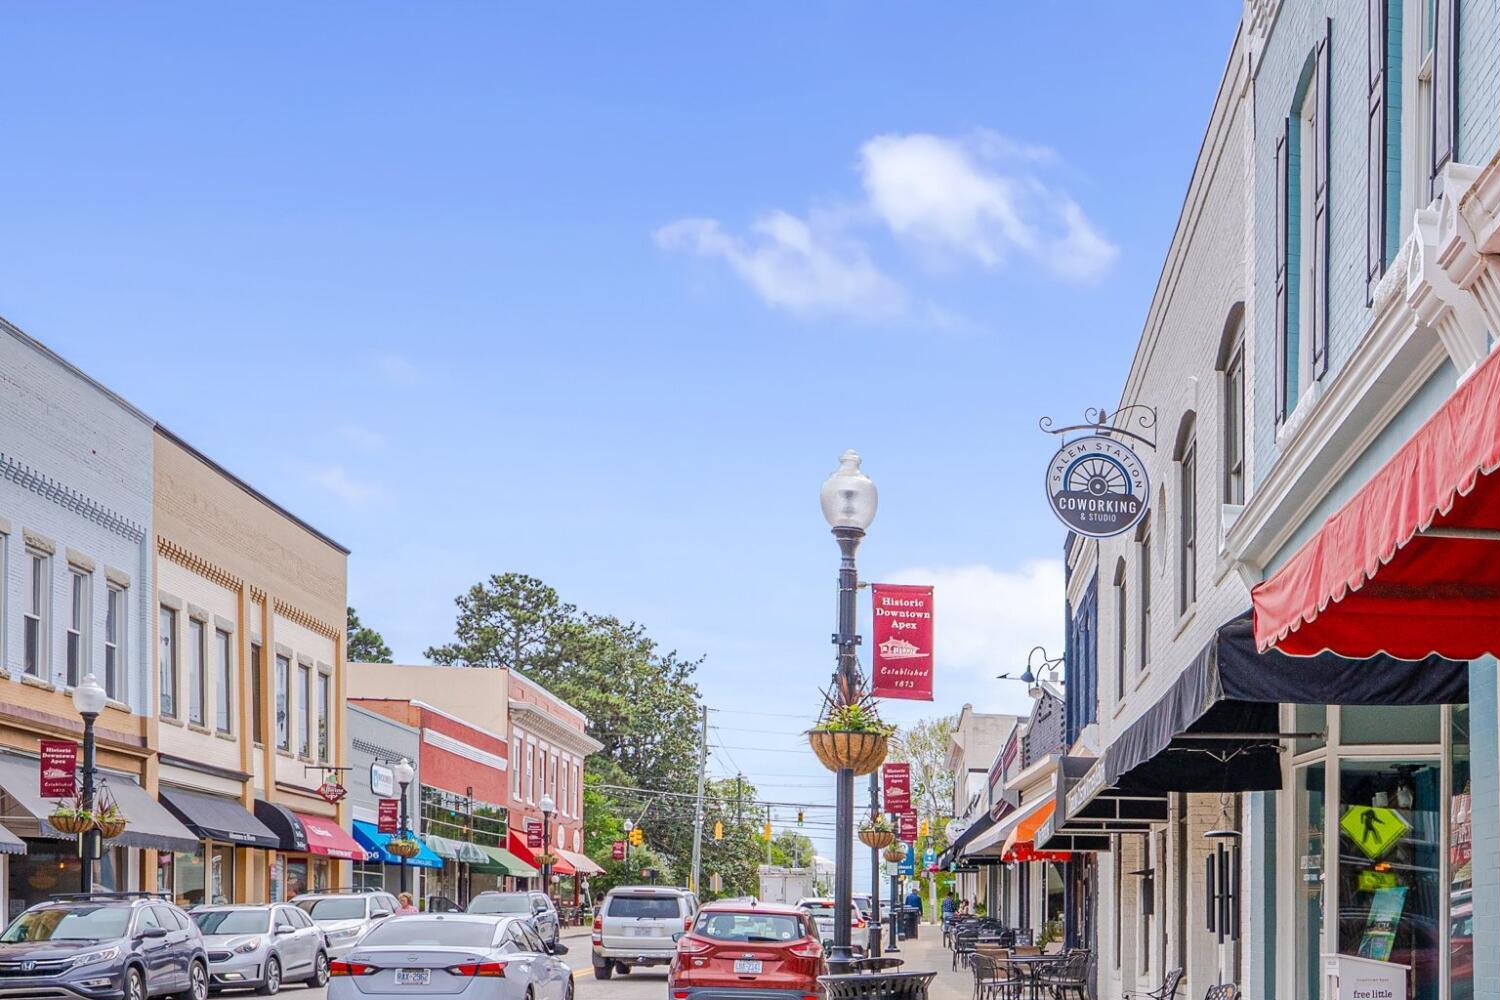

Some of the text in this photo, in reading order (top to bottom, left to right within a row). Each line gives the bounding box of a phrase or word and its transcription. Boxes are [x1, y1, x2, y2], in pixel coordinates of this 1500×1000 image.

[1053, 442, 1143, 488] SALEM STATION
[1059, 497, 1137, 514] COWORKING
[1080, 512, 1117, 522] & STUDIO
[882, 597, 924, 607] Historic
[876, 608, 930, 619] Downtown
[891, 619, 917, 630] Apex
[881, 667, 929, 677] Established
[1354, 989, 1392, 999] free little
